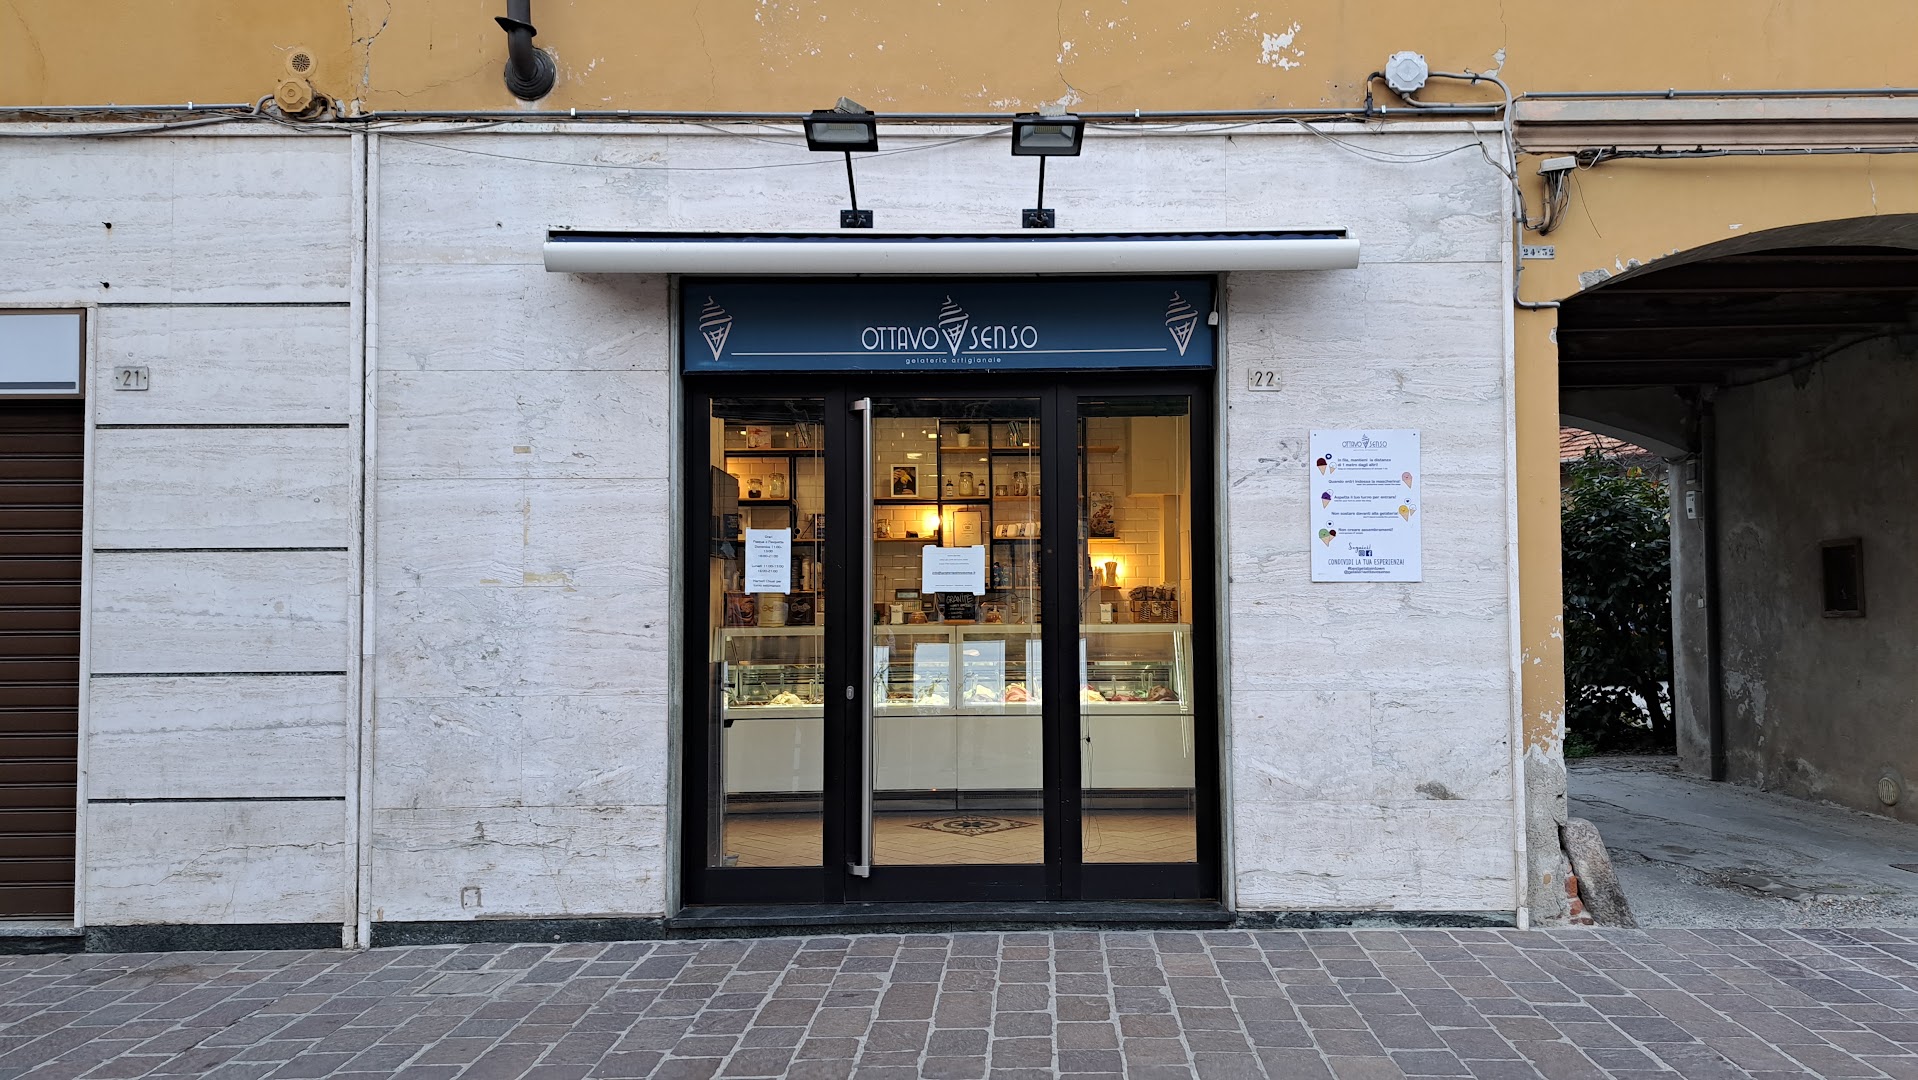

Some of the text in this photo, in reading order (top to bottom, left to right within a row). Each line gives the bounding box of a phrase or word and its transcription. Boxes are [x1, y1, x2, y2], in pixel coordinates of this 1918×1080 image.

[862, 325, 1038, 350] OTTAVO SENSO
[951, 356, 1002, 364] artigianale
[123, 370, 139, 386] 21
[1255, 371, 1274, 386] 22
